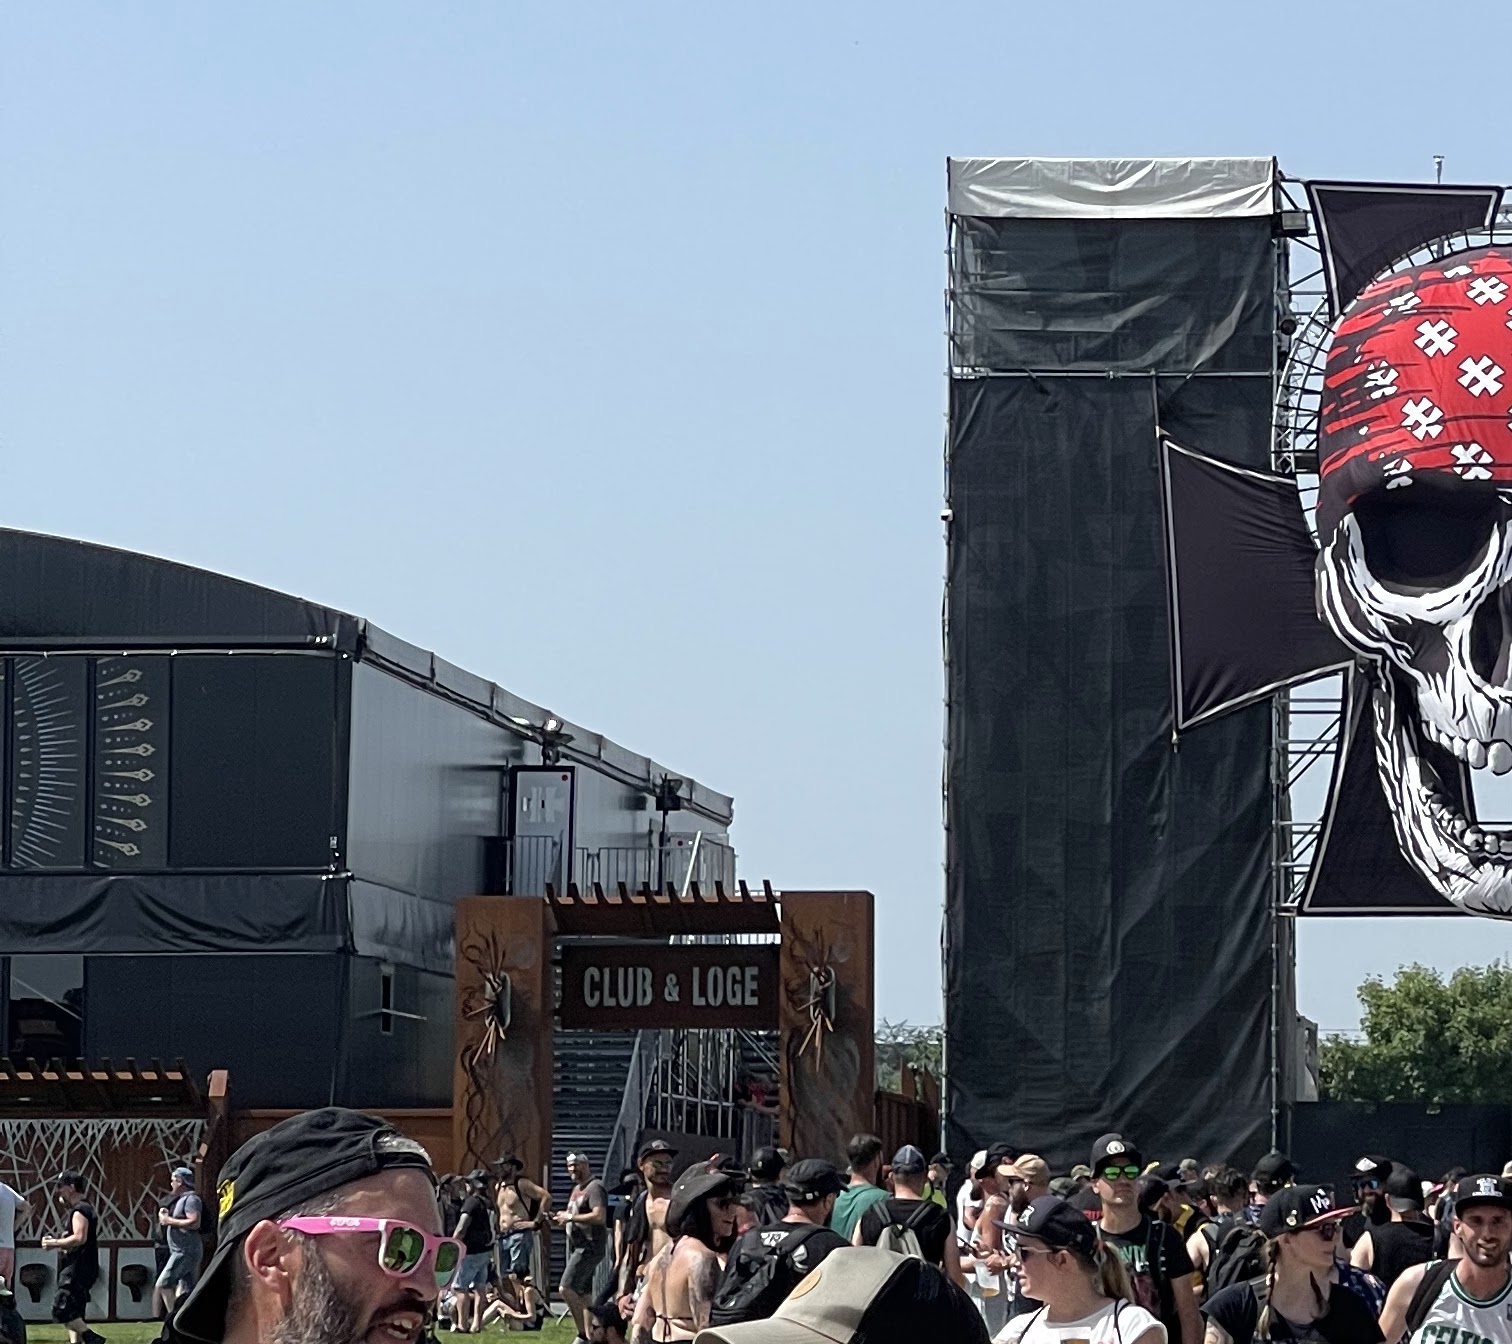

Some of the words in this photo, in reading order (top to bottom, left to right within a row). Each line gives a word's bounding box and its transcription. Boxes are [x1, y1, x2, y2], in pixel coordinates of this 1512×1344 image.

[583, 966, 653, 1007] CLUB
[664, 973, 680, 1002] &
[692, 966, 759, 1006] LOGE
